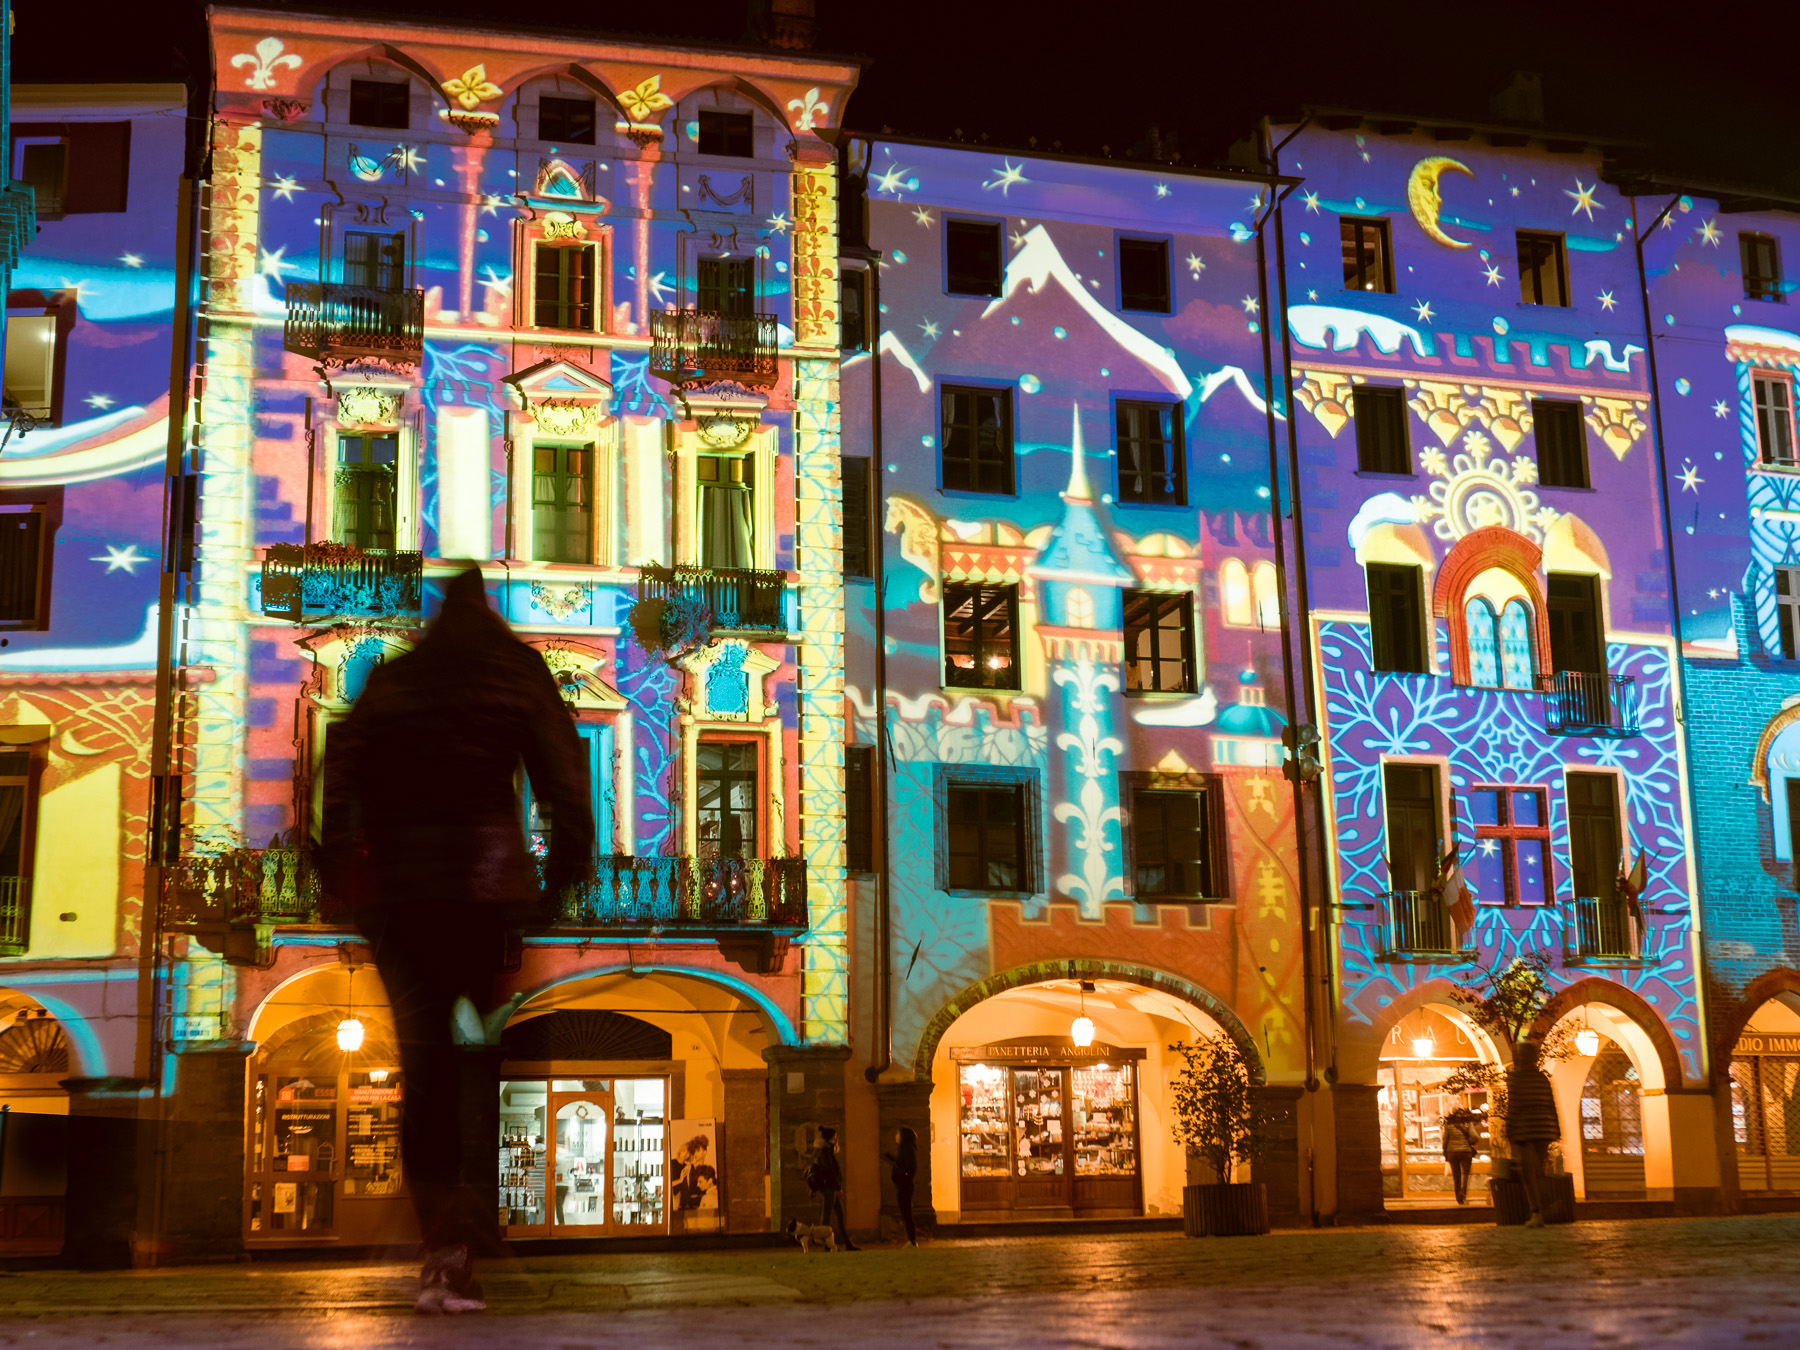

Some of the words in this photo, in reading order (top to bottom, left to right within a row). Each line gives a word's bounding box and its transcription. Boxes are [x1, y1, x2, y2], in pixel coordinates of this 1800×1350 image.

[1735, 1037, 1764, 1052] DIO
[1768, 1038, 1800, 1052] IMM
[989, 1046, 1050, 1057] PANETTERIA
[1060, 1046, 1110, 1057] ANGIOLINI
